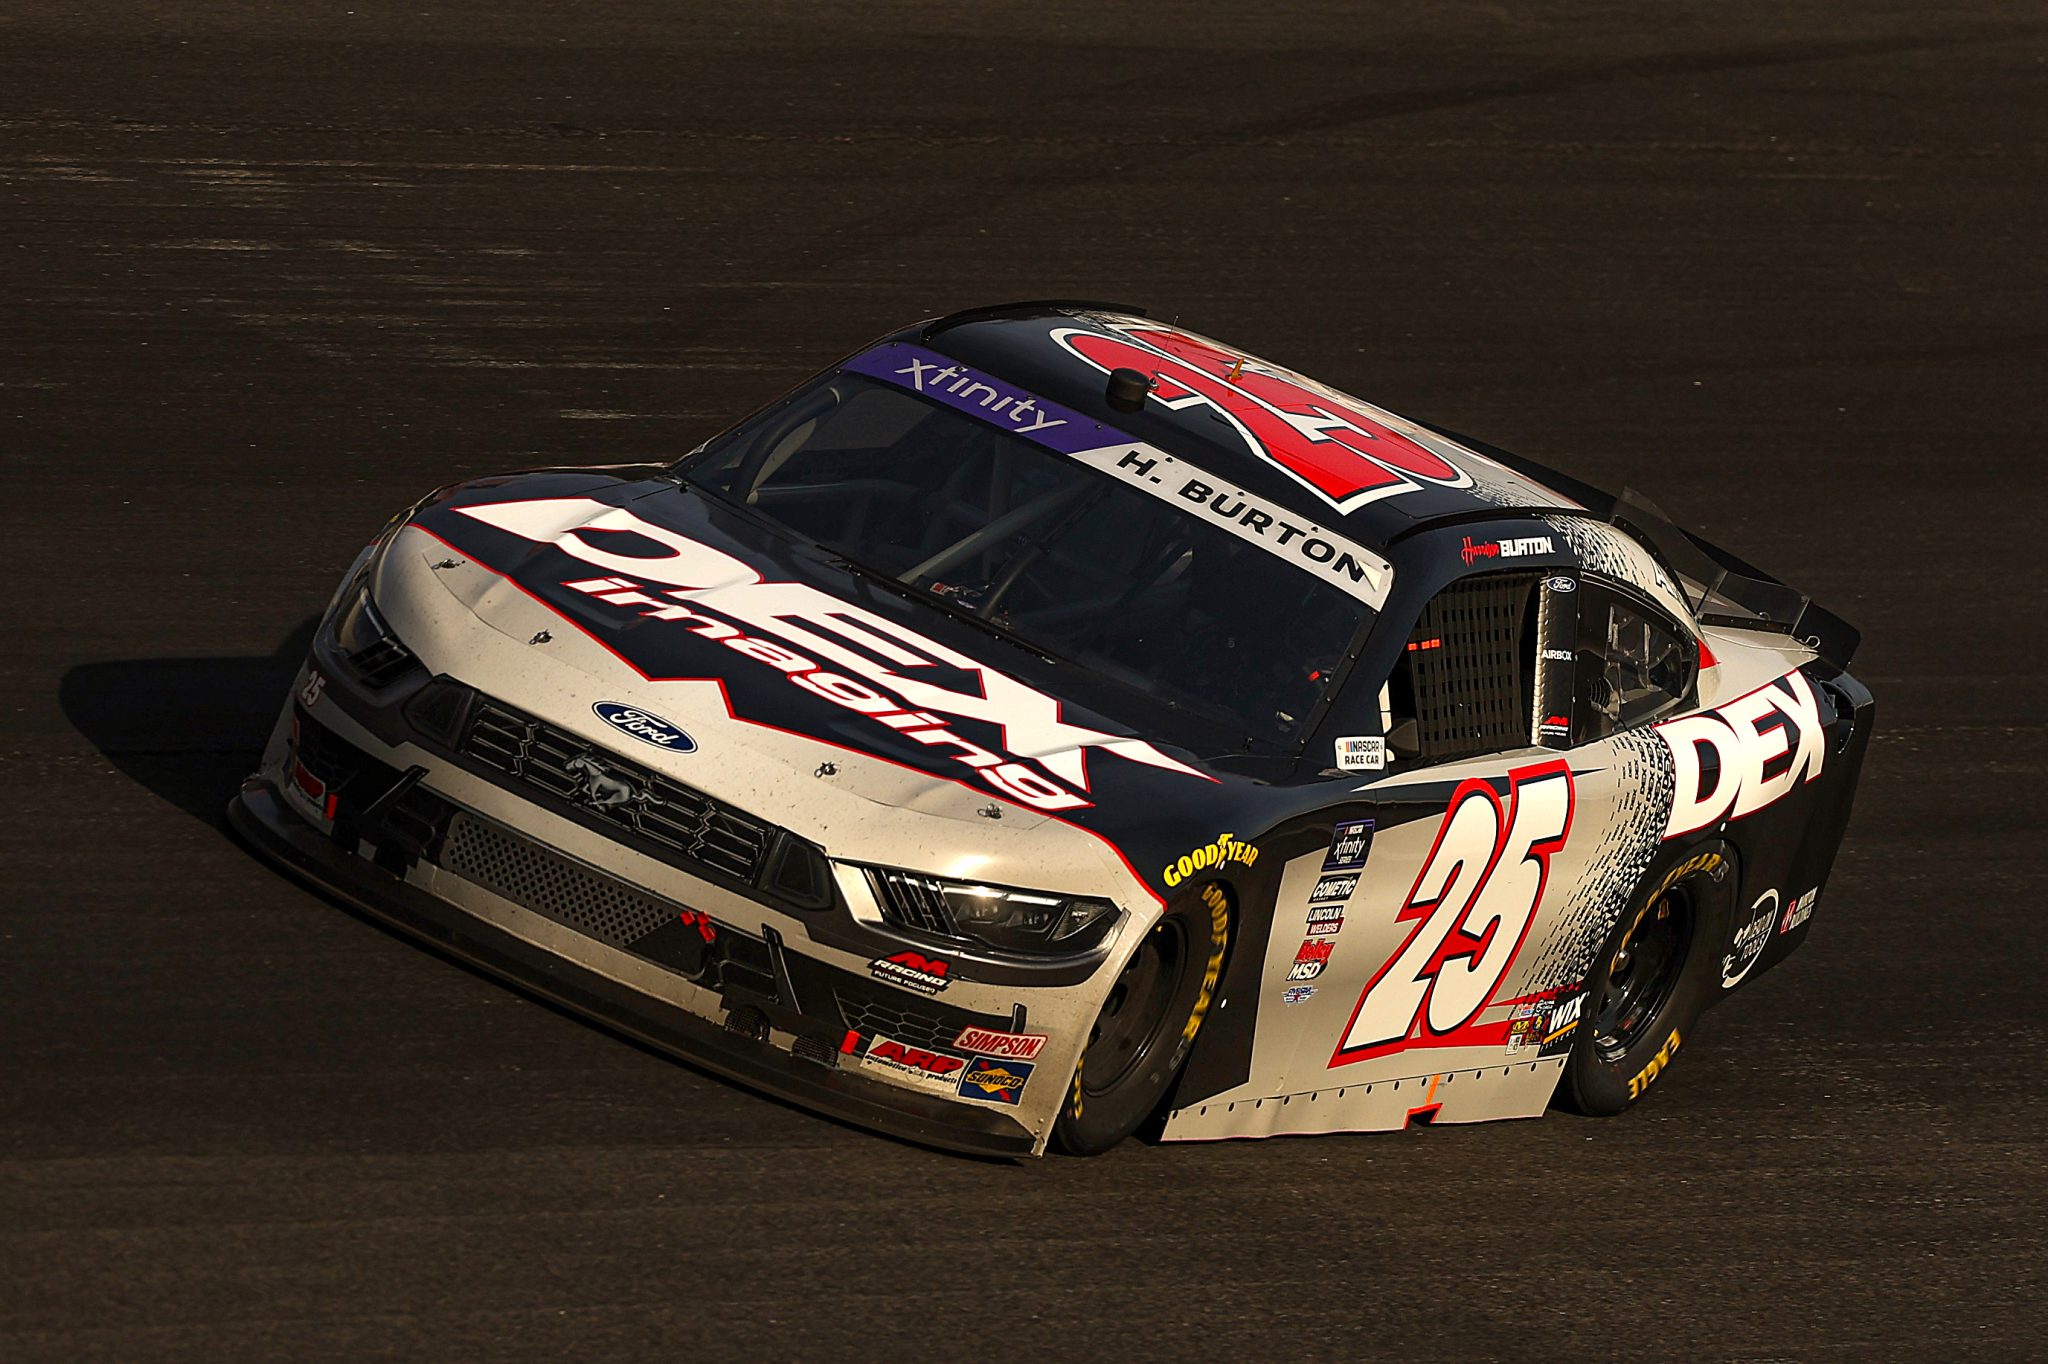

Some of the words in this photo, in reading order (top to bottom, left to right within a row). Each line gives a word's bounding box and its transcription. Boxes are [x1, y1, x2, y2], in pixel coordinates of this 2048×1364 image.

[894, 356, 1068, 433] xfinity
[1115, 449, 1162, 484] H.
[1176, 479, 1367, 583] BURTON
[1497, 536, 1556, 558] BURTON
[450, 497, 1219, 793] DEX
[1541, 650, 1573, 661] AIRBOX
[301, 670, 326, 706] 25
[560, 575, 1096, 813] imaging
[609, 709, 680, 745] Ford
[1344, 755, 1365, 766] RACE
[1366, 754, 1380, 765] CAR
[1352, 740, 1380, 753] NASCAR
[1651, 668, 1826, 840] DEX
[1333, 835, 1366, 860] xfinity
[1312, 879, 1357, 898] COMETIC
[1307, 907, 1342, 922] LINCOLN
[1333, 762, 1575, 1063] 25
[1310, 922, 1339, 934] WELDERS
[873, 959, 949, 987] RACING
[873, 970, 902, 983] FUTURE
[884, 950, 950, 977] AM
[1286, 961, 1322, 981] MSD
[1548, 991, 1588, 1034] WIX
[959, 1030, 1042, 1057] SIMPSON
[868, 1040, 964, 1075] ARP
[1627, 1026, 1682, 1101] EAGLE
[968, 1071, 1022, 1088] SUNOCO
